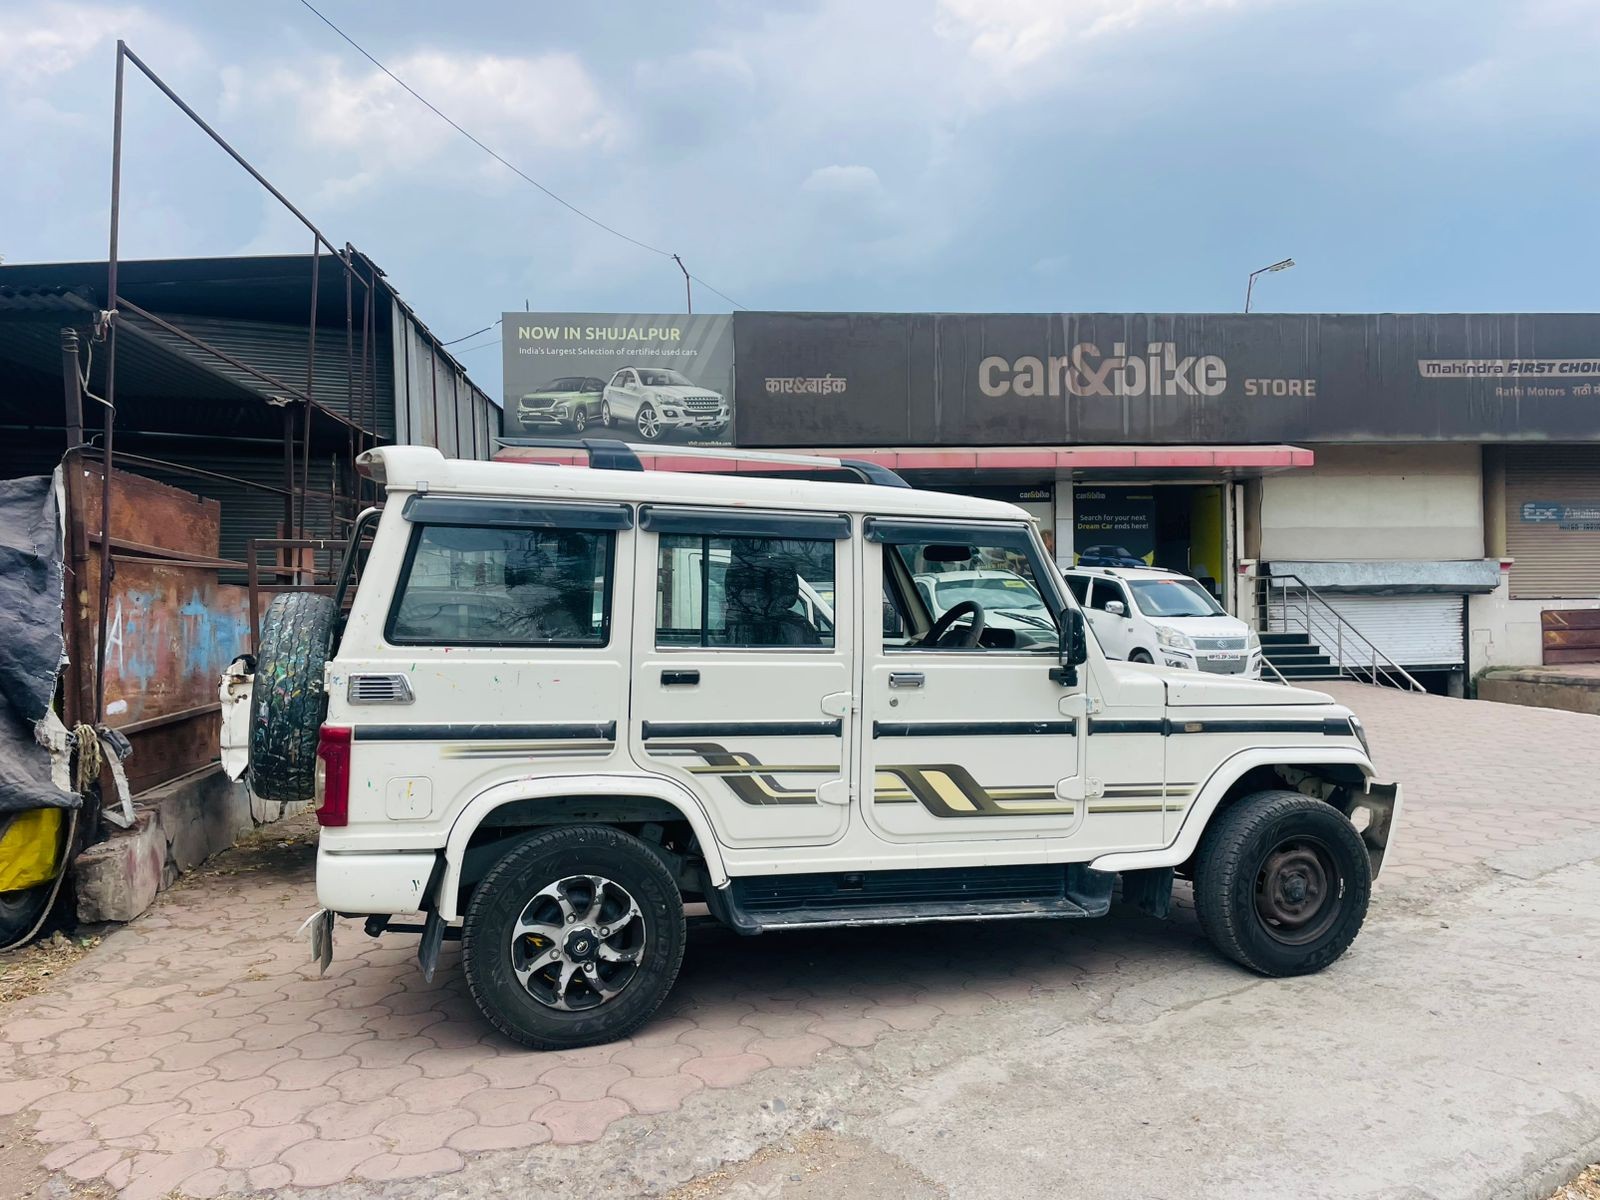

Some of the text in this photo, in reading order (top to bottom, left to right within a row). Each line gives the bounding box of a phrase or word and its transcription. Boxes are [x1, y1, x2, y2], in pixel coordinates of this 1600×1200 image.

[518, 326, 681, 341] NOW IN SHUJALPUR
[519, 347, 545, 355] India's
[546, 347, 577, 357] Largest
[577, 347, 615, 356] Selection
[616, 347, 625, 356] of
[626, 347, 660, 356] certified
[661, 348, 680, 356] used
[979, 342, 1316, 397] car&bike STORE
[1426, 362, 1600, 374] Mahindra FIRST CHOI
[1495, 387, 1566, 397] Rathi Motors
